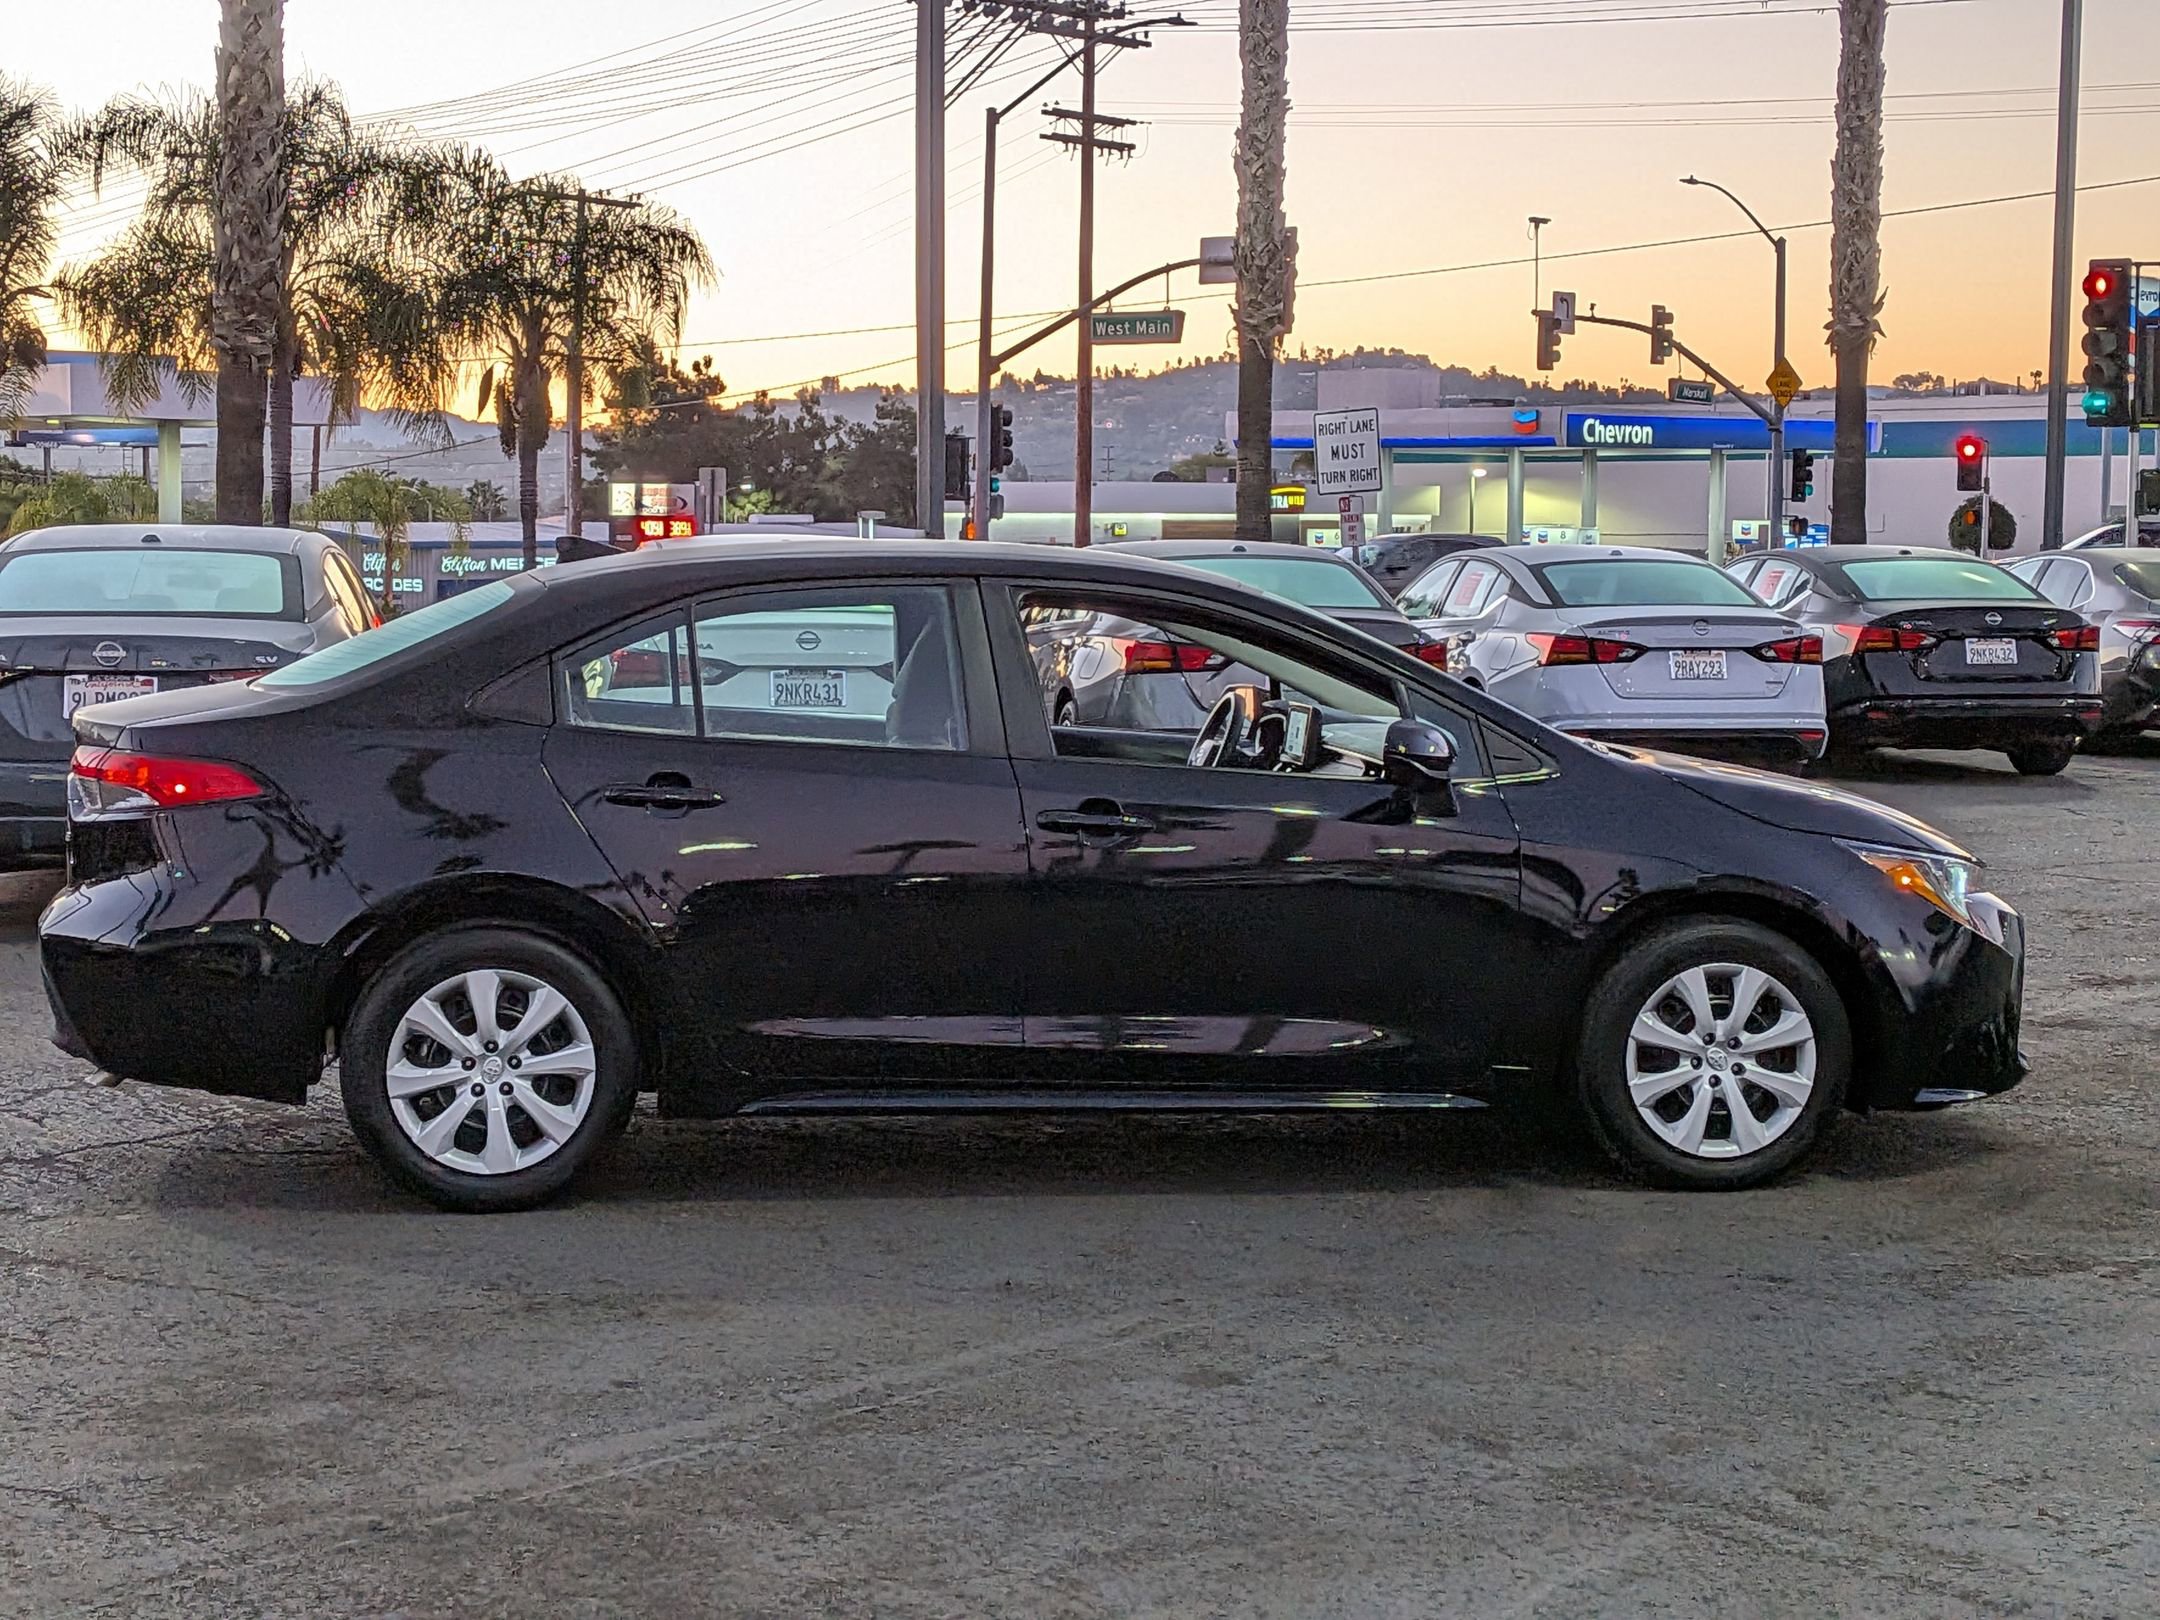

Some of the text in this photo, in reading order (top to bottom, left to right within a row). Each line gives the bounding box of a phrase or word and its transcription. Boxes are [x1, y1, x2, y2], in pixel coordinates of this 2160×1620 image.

[1096, 319, 1170, 336] West Main
[1318, 418, 1375, 436] RIGHT LANE
[1582, 417, 1653, 445] Chevron
[1331, 442, 1366, 461] MUST
[1320, 467, 1378, 485] TURN RIGHT
[441, 556, 488, 577] Clifton
[1970, 647, 2014, 663] 9NKR432
[1674, 660, 1723, 677] 9RAY293
[775, 683, 839, 702] 9NKR431
